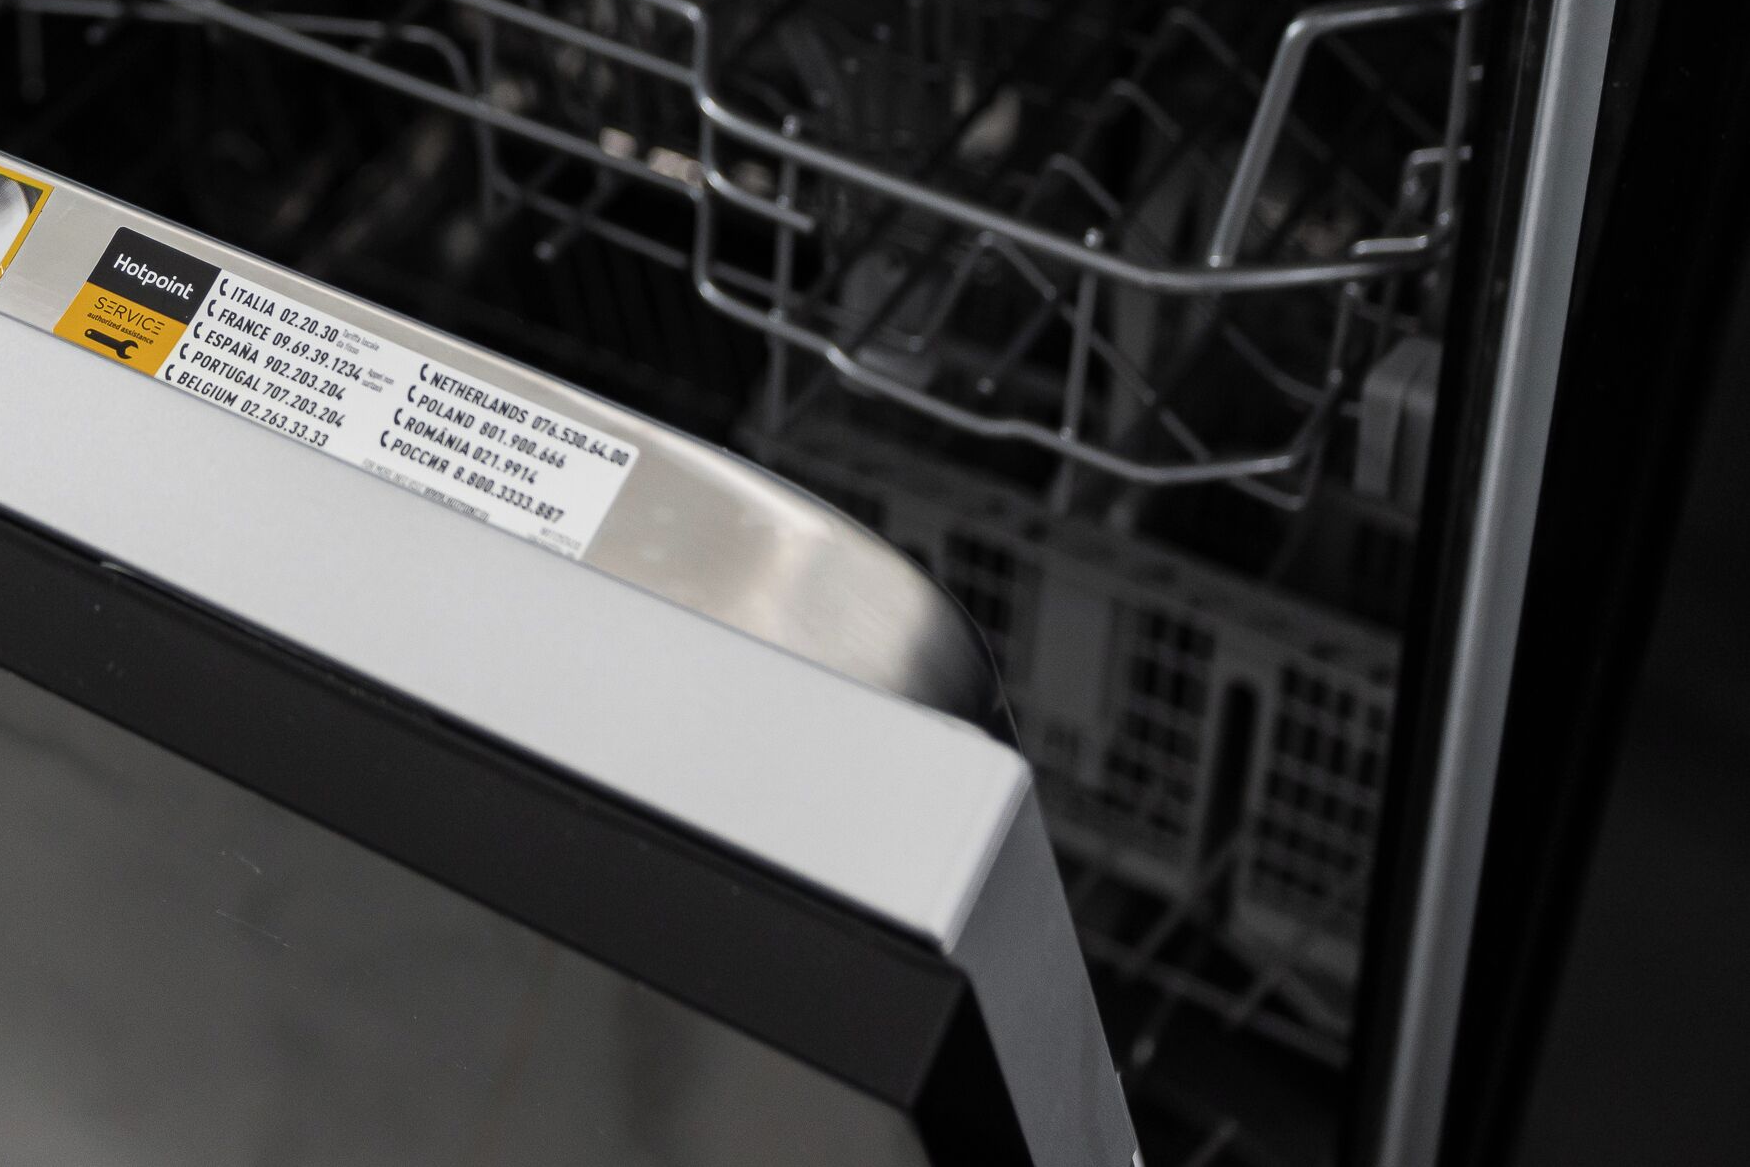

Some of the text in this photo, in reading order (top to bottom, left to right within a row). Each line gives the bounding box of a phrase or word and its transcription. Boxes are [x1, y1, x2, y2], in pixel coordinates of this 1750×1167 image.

[113, 253, 194, 300] Hotpoint
[87, 312, 154, 346] authorized assistance
[94, 296, 166, 336] SERVICE
[230, 286, 339, 344] ITALIA 02.20.30
[204, 329, 260, 365] ESPAÑA
[263, 355, 347, 401] 902.203.204
[217, 308, 272, 341] FRANCE
[272, 332, 364, 382] 09.69.39.1234
[176, 371, 330, 448] BELGIUM 02.263.33.33
[190, 350, 347, 429] PORTUGAL 707.203.204
[417, 394, 476, 430] POLAND
[429, 373, 529, 425] NETHERLANDS
[390, 437, 450, 475] РОССИЯ
[472, 446, 539, 486] 021.9914
